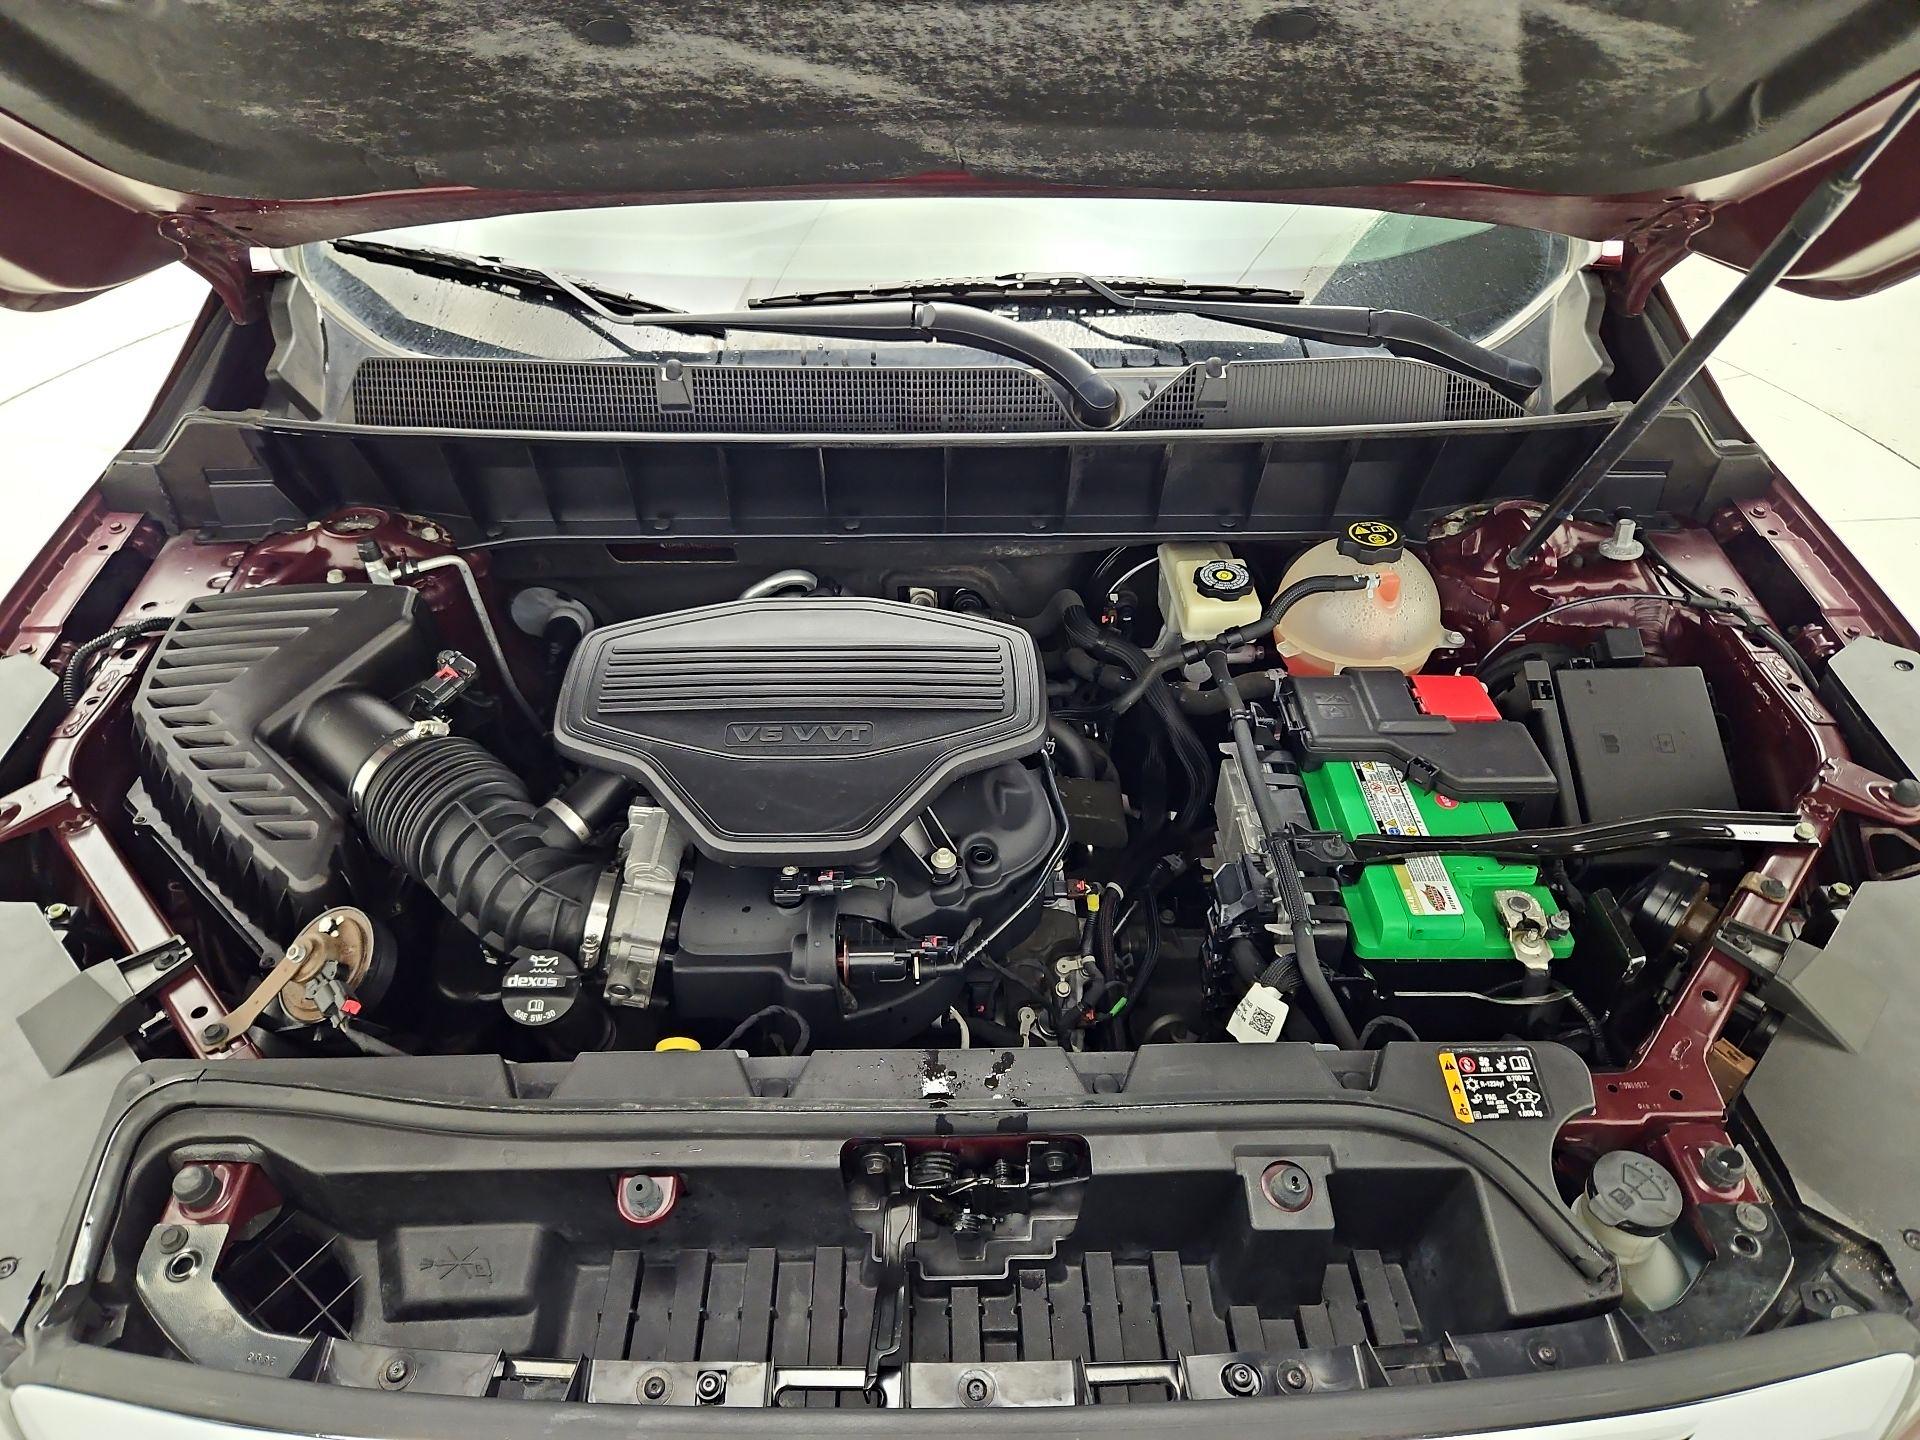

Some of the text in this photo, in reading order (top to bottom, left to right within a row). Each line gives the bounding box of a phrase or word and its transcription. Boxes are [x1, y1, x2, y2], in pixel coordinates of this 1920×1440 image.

[732, 725, 868, 742] V6 VVT
[507, 974, 560, 987] dexos
[514, 1009, 556, 1022] SAE 5W-30
